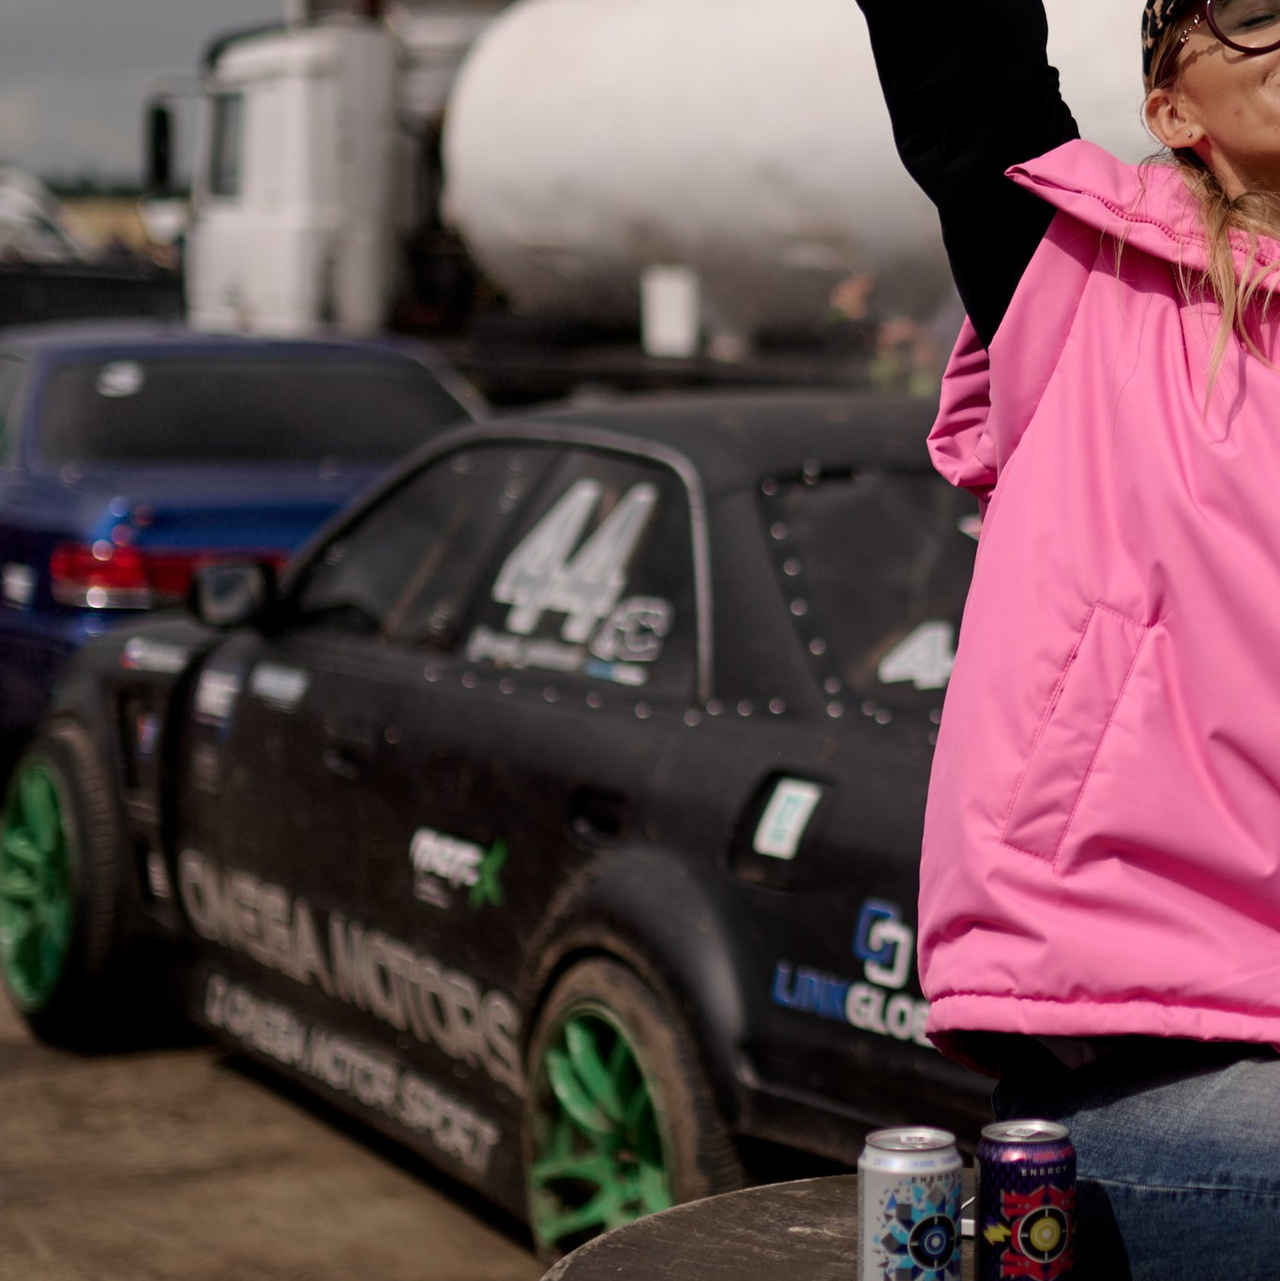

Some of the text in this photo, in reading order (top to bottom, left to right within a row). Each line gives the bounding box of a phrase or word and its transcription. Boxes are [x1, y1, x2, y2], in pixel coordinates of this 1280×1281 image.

[492, 479, 657, 643] 44
[328, 910, 529, 1099] MOTORS
[1021, 1164, 1068, 1177] ENERGY
